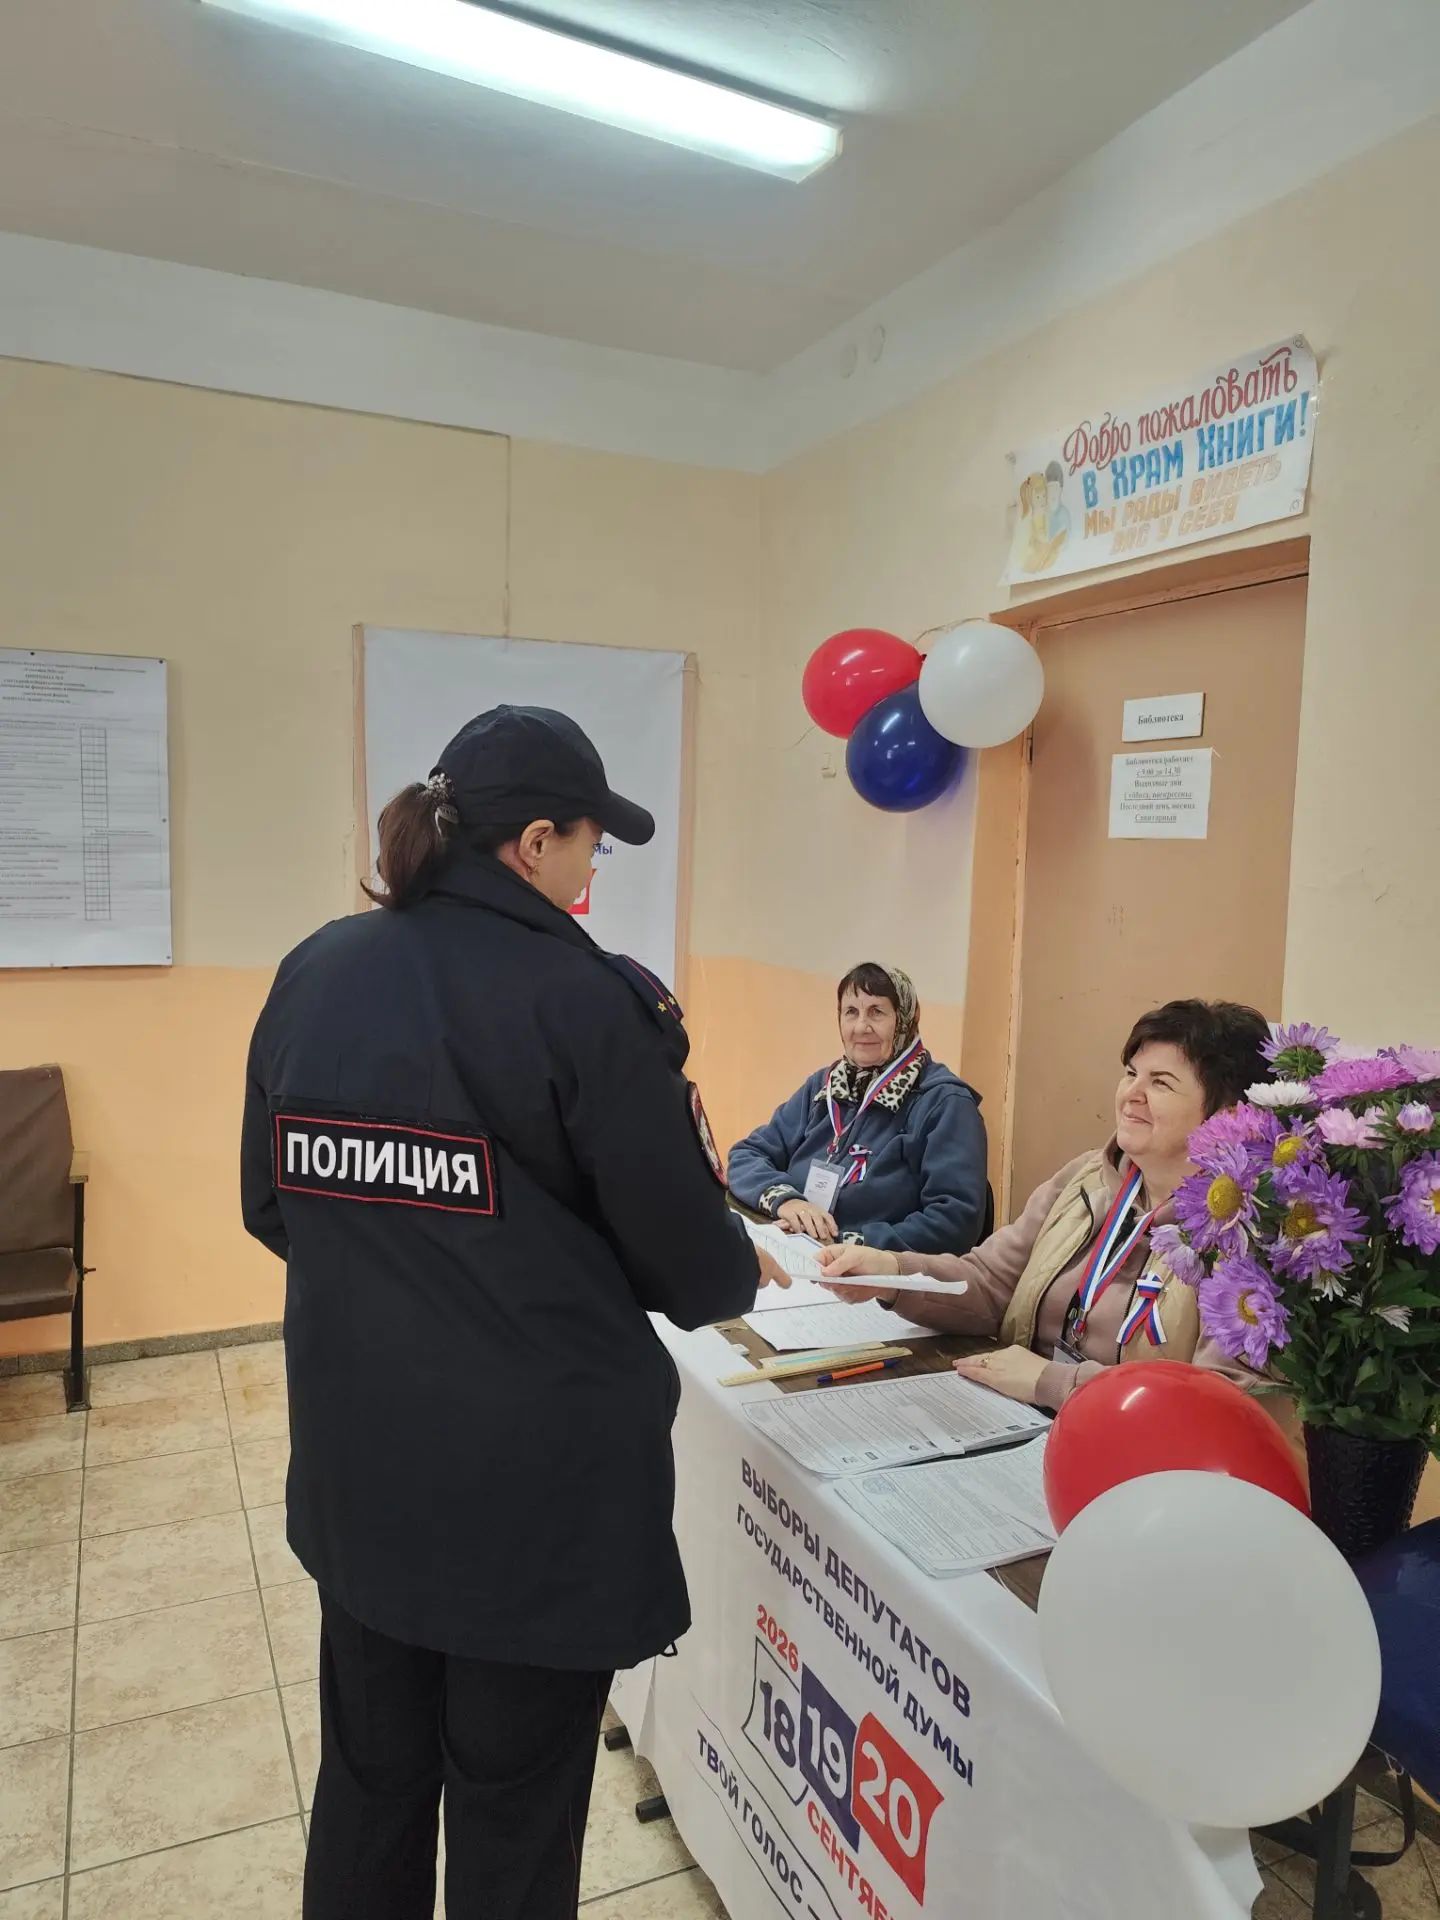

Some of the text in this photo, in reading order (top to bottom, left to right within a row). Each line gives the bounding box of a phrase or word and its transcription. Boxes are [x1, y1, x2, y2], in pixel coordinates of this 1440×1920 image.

[1063, 347, 1298, 476] Добро пожаловать
[1082, 391, 1310, 509] В ХРАМ КНИГИ!
[1084, 453, 1283, 539] МЫ РАДЫ ВИДЕТЬ
[1158, 516, 1173, 542] У
[1178, 494, 1240, 536] СЕБЯ
[1138, 713, 1184, 725] Библиотека
[287, 1131, 480, 1196] ПОЛИЦИЯ
[737, 1504, 900, 1701] ГОСУДАРСТВЕННОЙ
[903, 1693, 974, 1787] ДУМЫ
[742, 1457, 820, 1561] ВЫБОРЫ
[825, 1546, 972, 1718] ДЕПУТАТОВ
[756, 1604, 800, 1673] 2026
[697, 1728, 803, 1904] ТВОЙ ГОЛОС
[758, 1680, 922, 1859] 18 19 20
[807, 1799, 896, 1920] СЕНТЯБ
